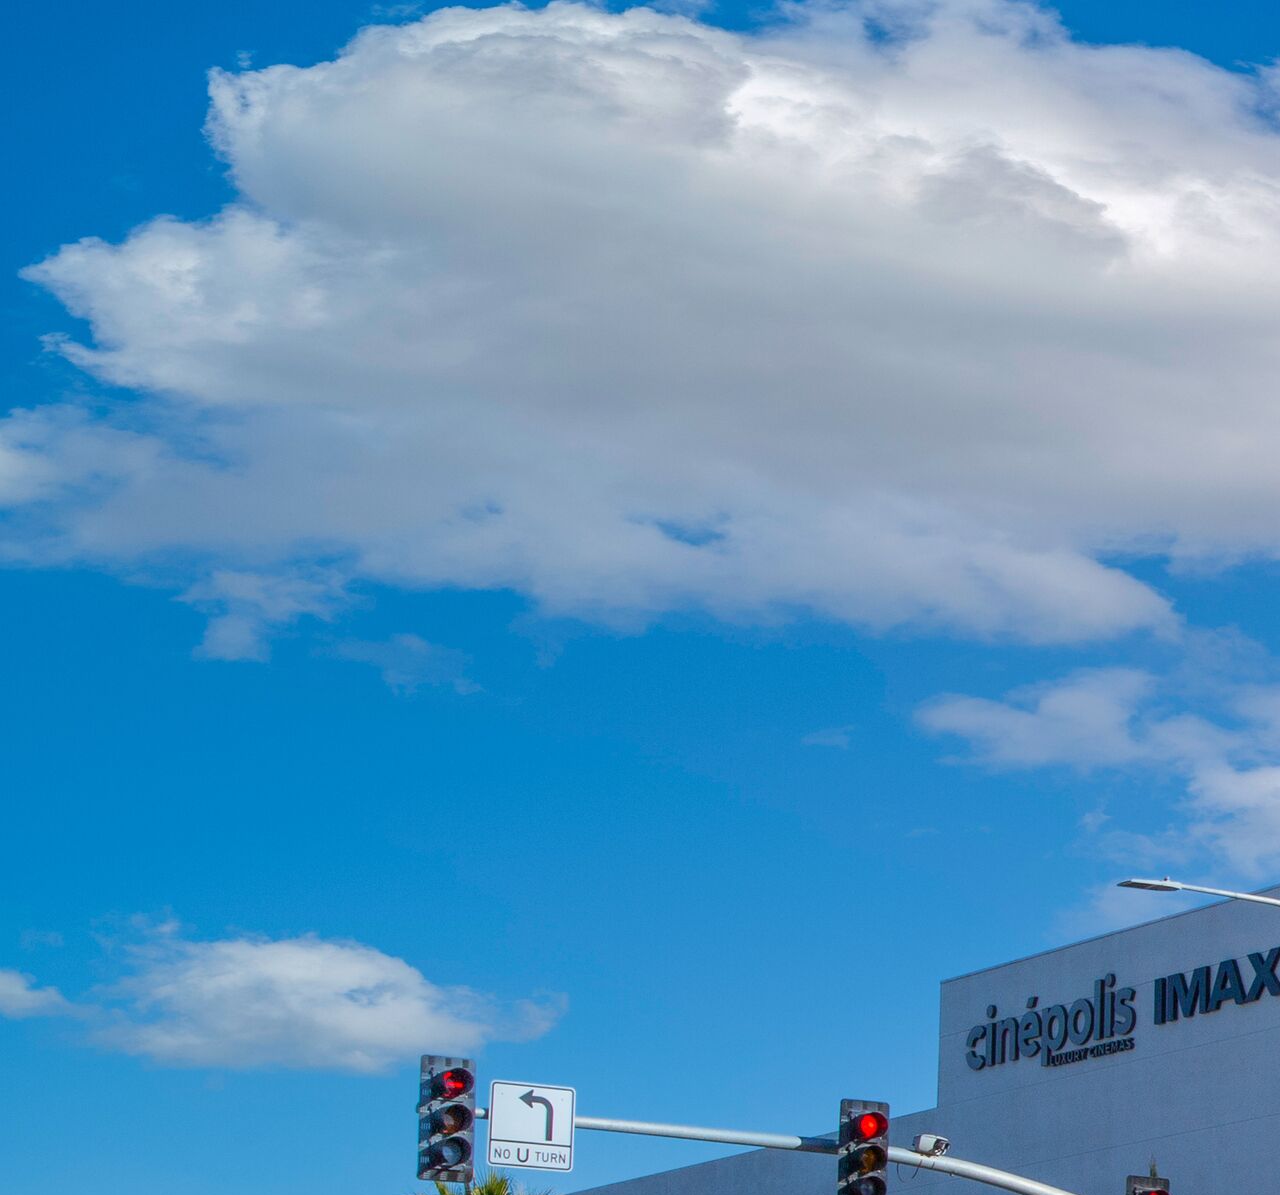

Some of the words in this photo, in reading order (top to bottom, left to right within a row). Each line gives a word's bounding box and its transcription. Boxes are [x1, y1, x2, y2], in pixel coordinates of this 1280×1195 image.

[965, 972, 1137, 1071] cinépolis
[1049, 1047, 1088, 1067] LUXURY
[1089, 1038, 1135, 1058] CINEMAS
[494, 1147, 511, 1160] NO
[516, 1147, 530, 1163] U
[535, 1151, 567, 1164] TURN
